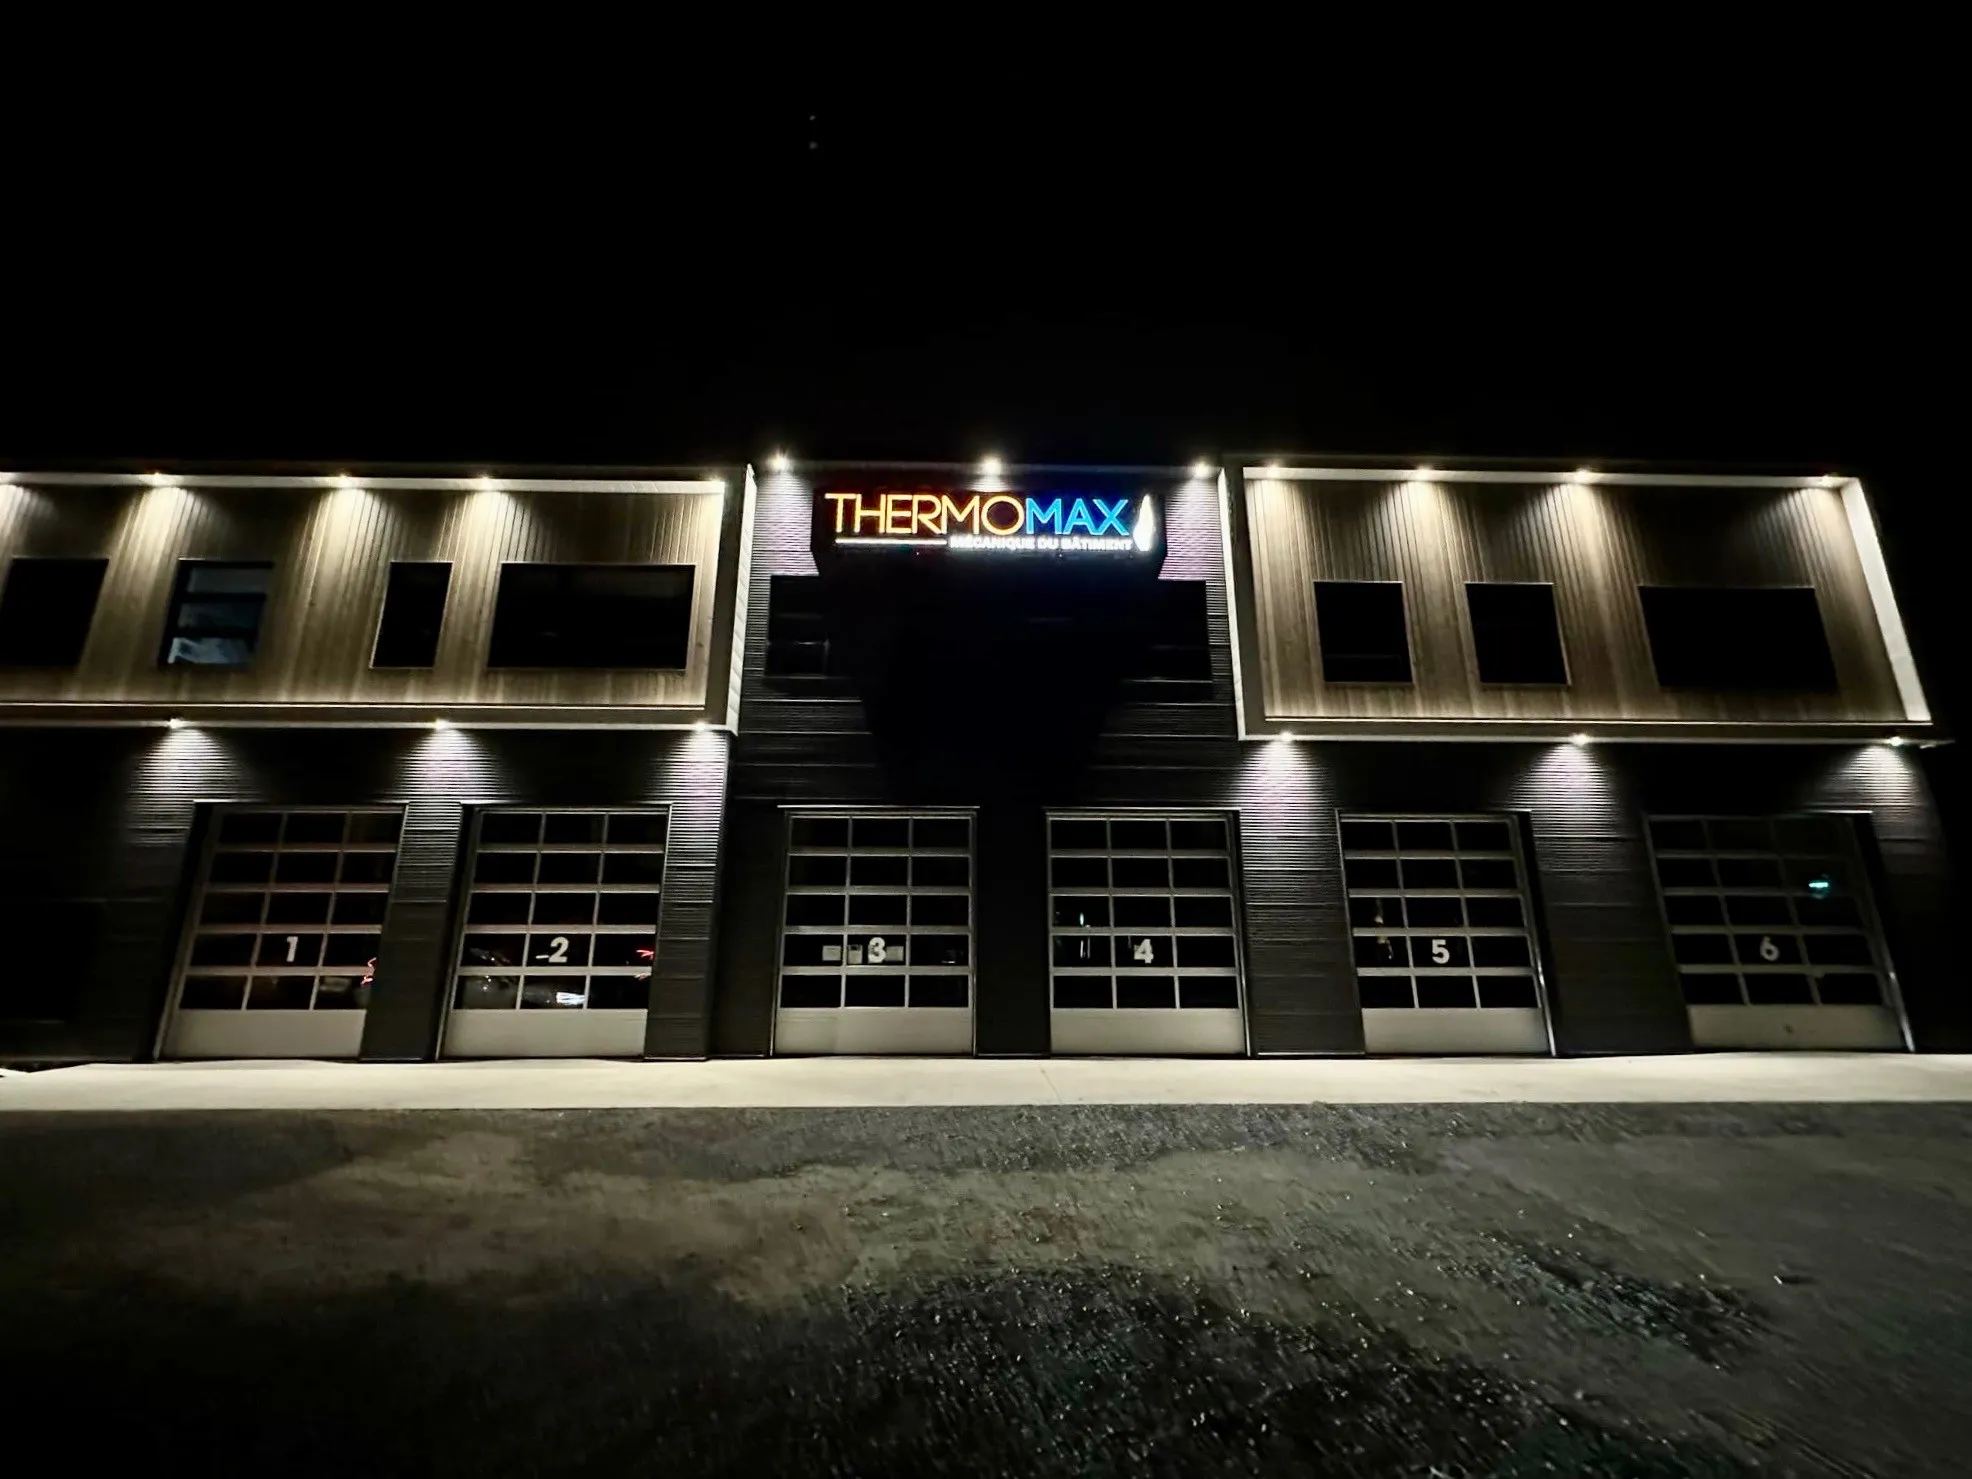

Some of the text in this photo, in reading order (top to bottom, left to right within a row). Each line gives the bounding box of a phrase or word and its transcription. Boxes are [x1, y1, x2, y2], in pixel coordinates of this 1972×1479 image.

[825, 493, 1129, 536] THERMOMAX
[1037, 536, 1059, 551] DU
[286, 936, 299, 962] 1
[549, 937, 569, 963] 2
[868, 937, 886, 964] 3
[1134, 938, 1154, 964] 4
[1431, 939, 1451, 964] 5
[1760, 936, 1780, 962] 6
